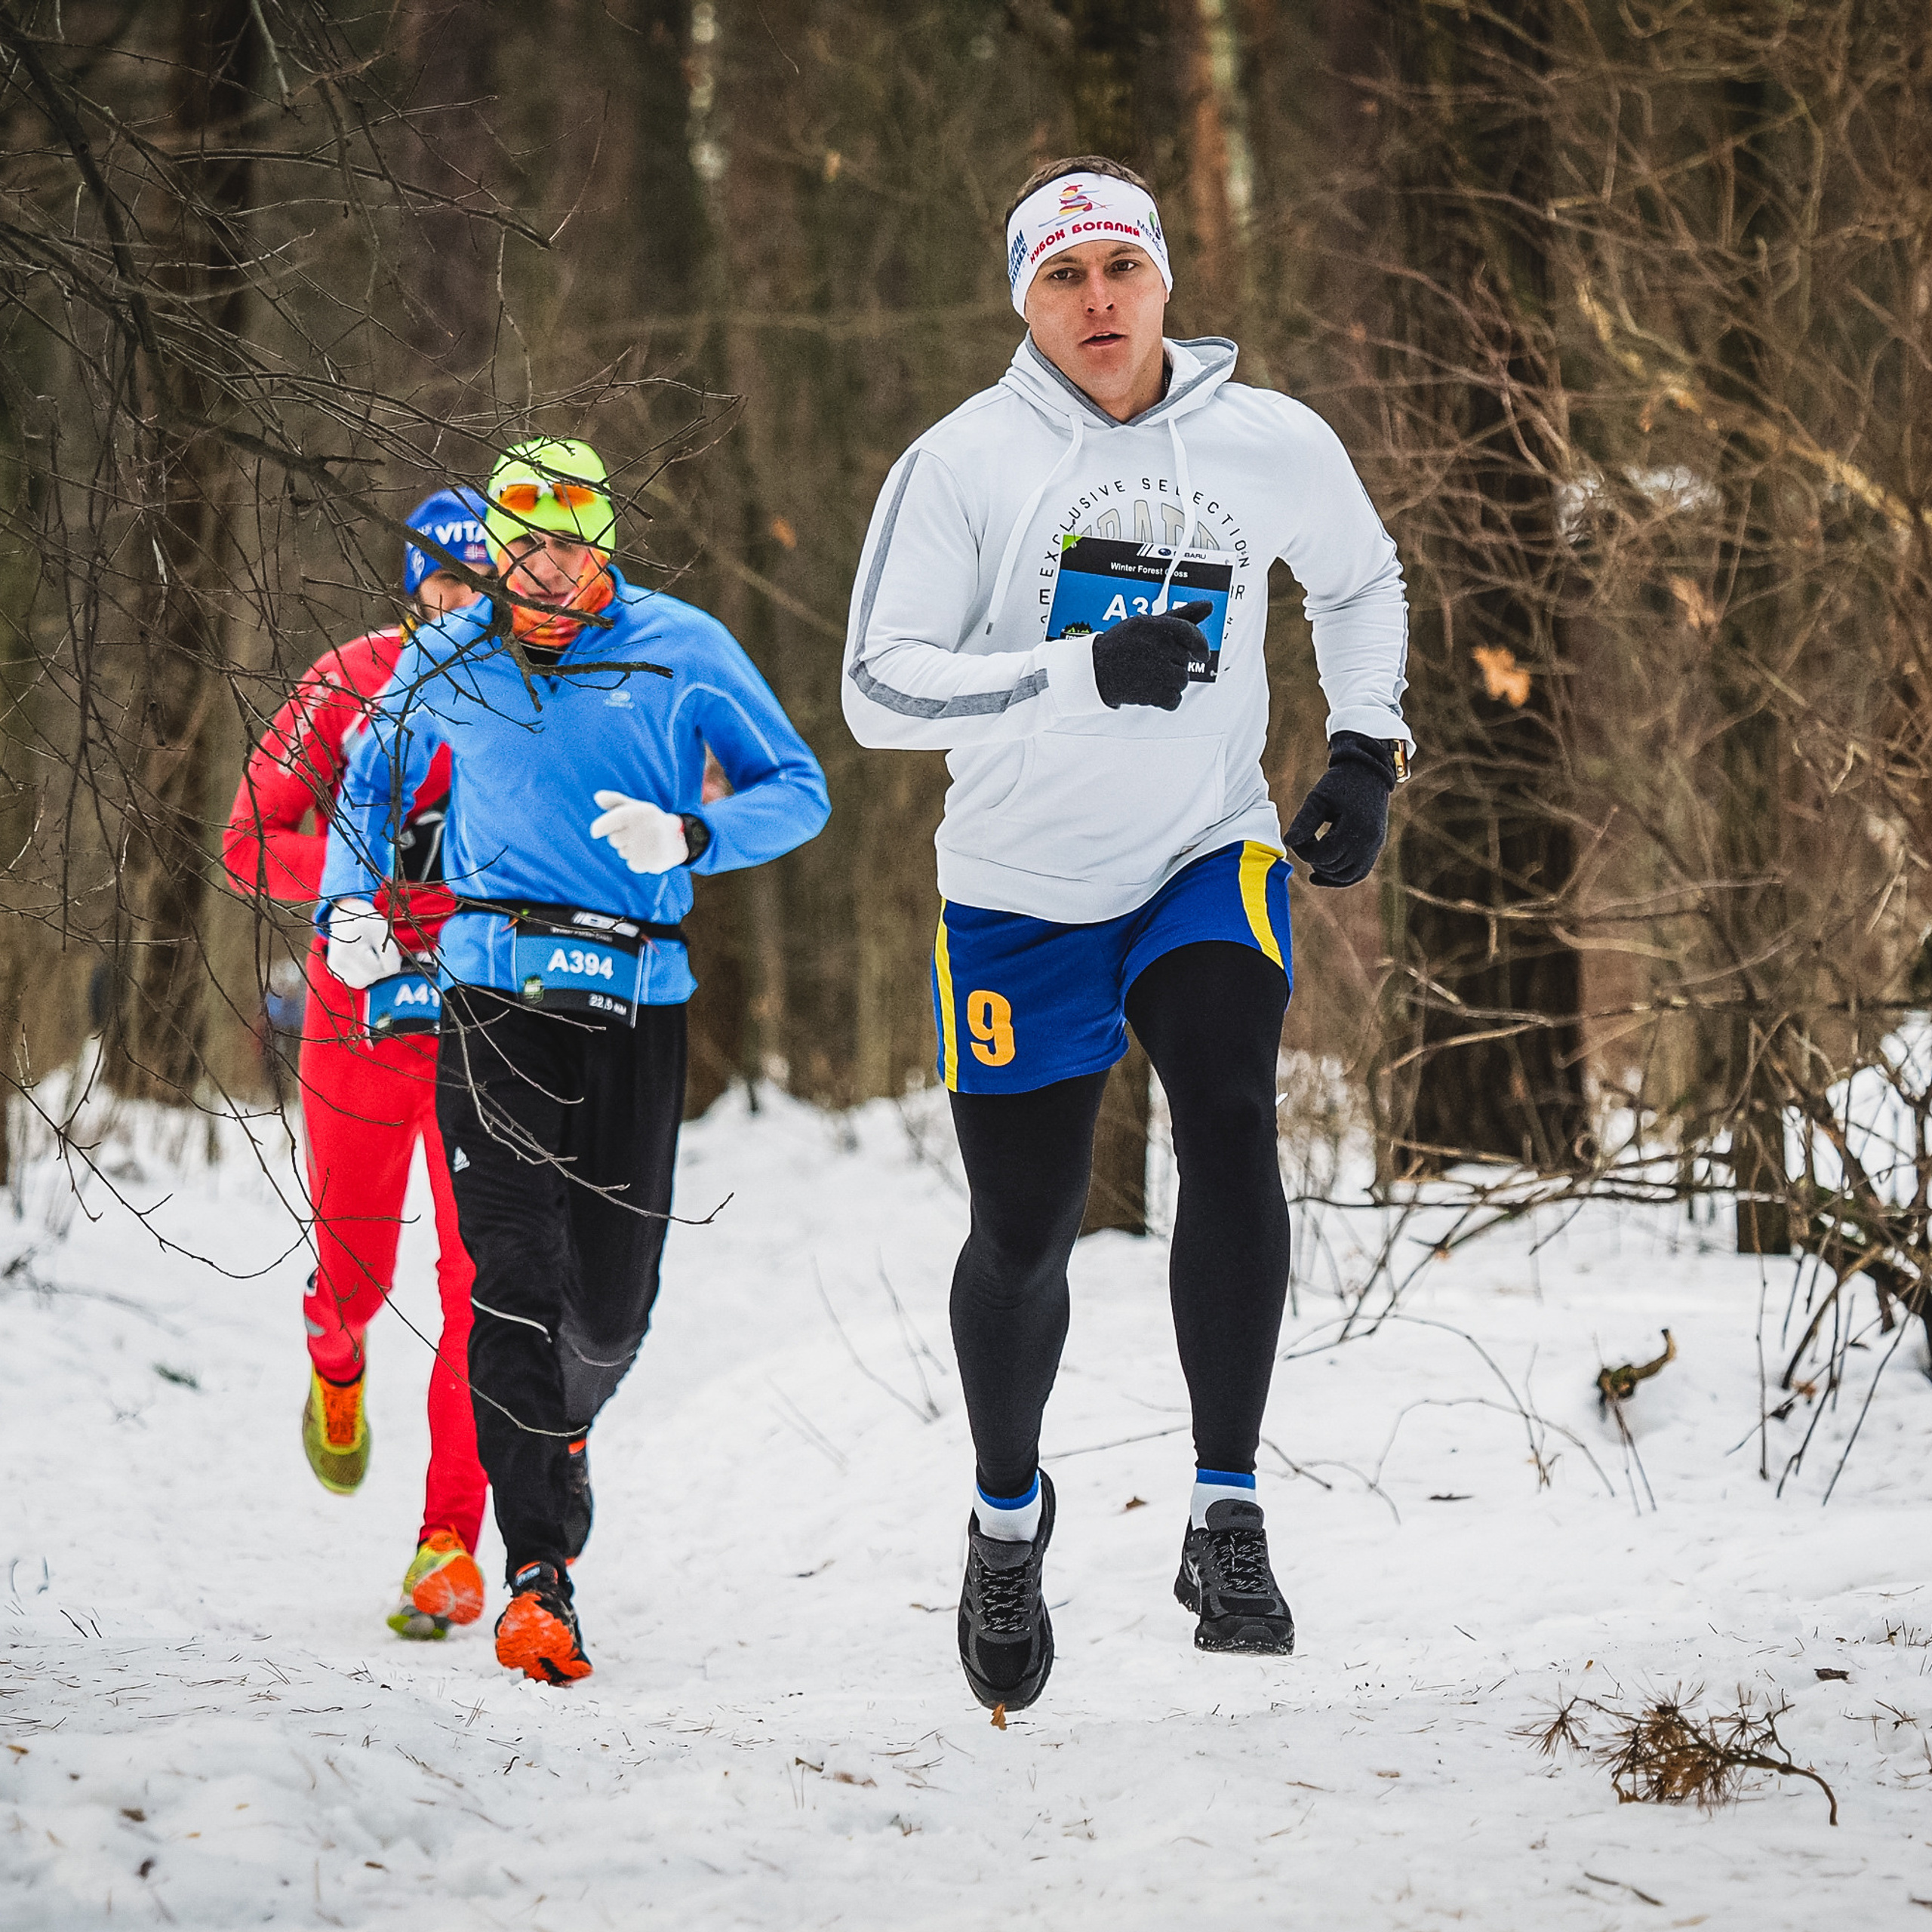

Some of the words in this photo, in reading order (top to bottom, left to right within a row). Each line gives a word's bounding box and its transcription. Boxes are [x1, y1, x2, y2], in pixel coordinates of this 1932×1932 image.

[1040, 480, 1125, 577] EXCLUSIVE
[1174, 551, 1207, 560] BARU
[1110, 561, 1137, 573] Winter
[1137, 565, 1163, 576] Forest
[1164, 568, 1189, 578] Coss
[1187, 661, 1206, 674] KM
[547, 948, 614, 980] A394
[967, 989, 1016, 1066] 9
